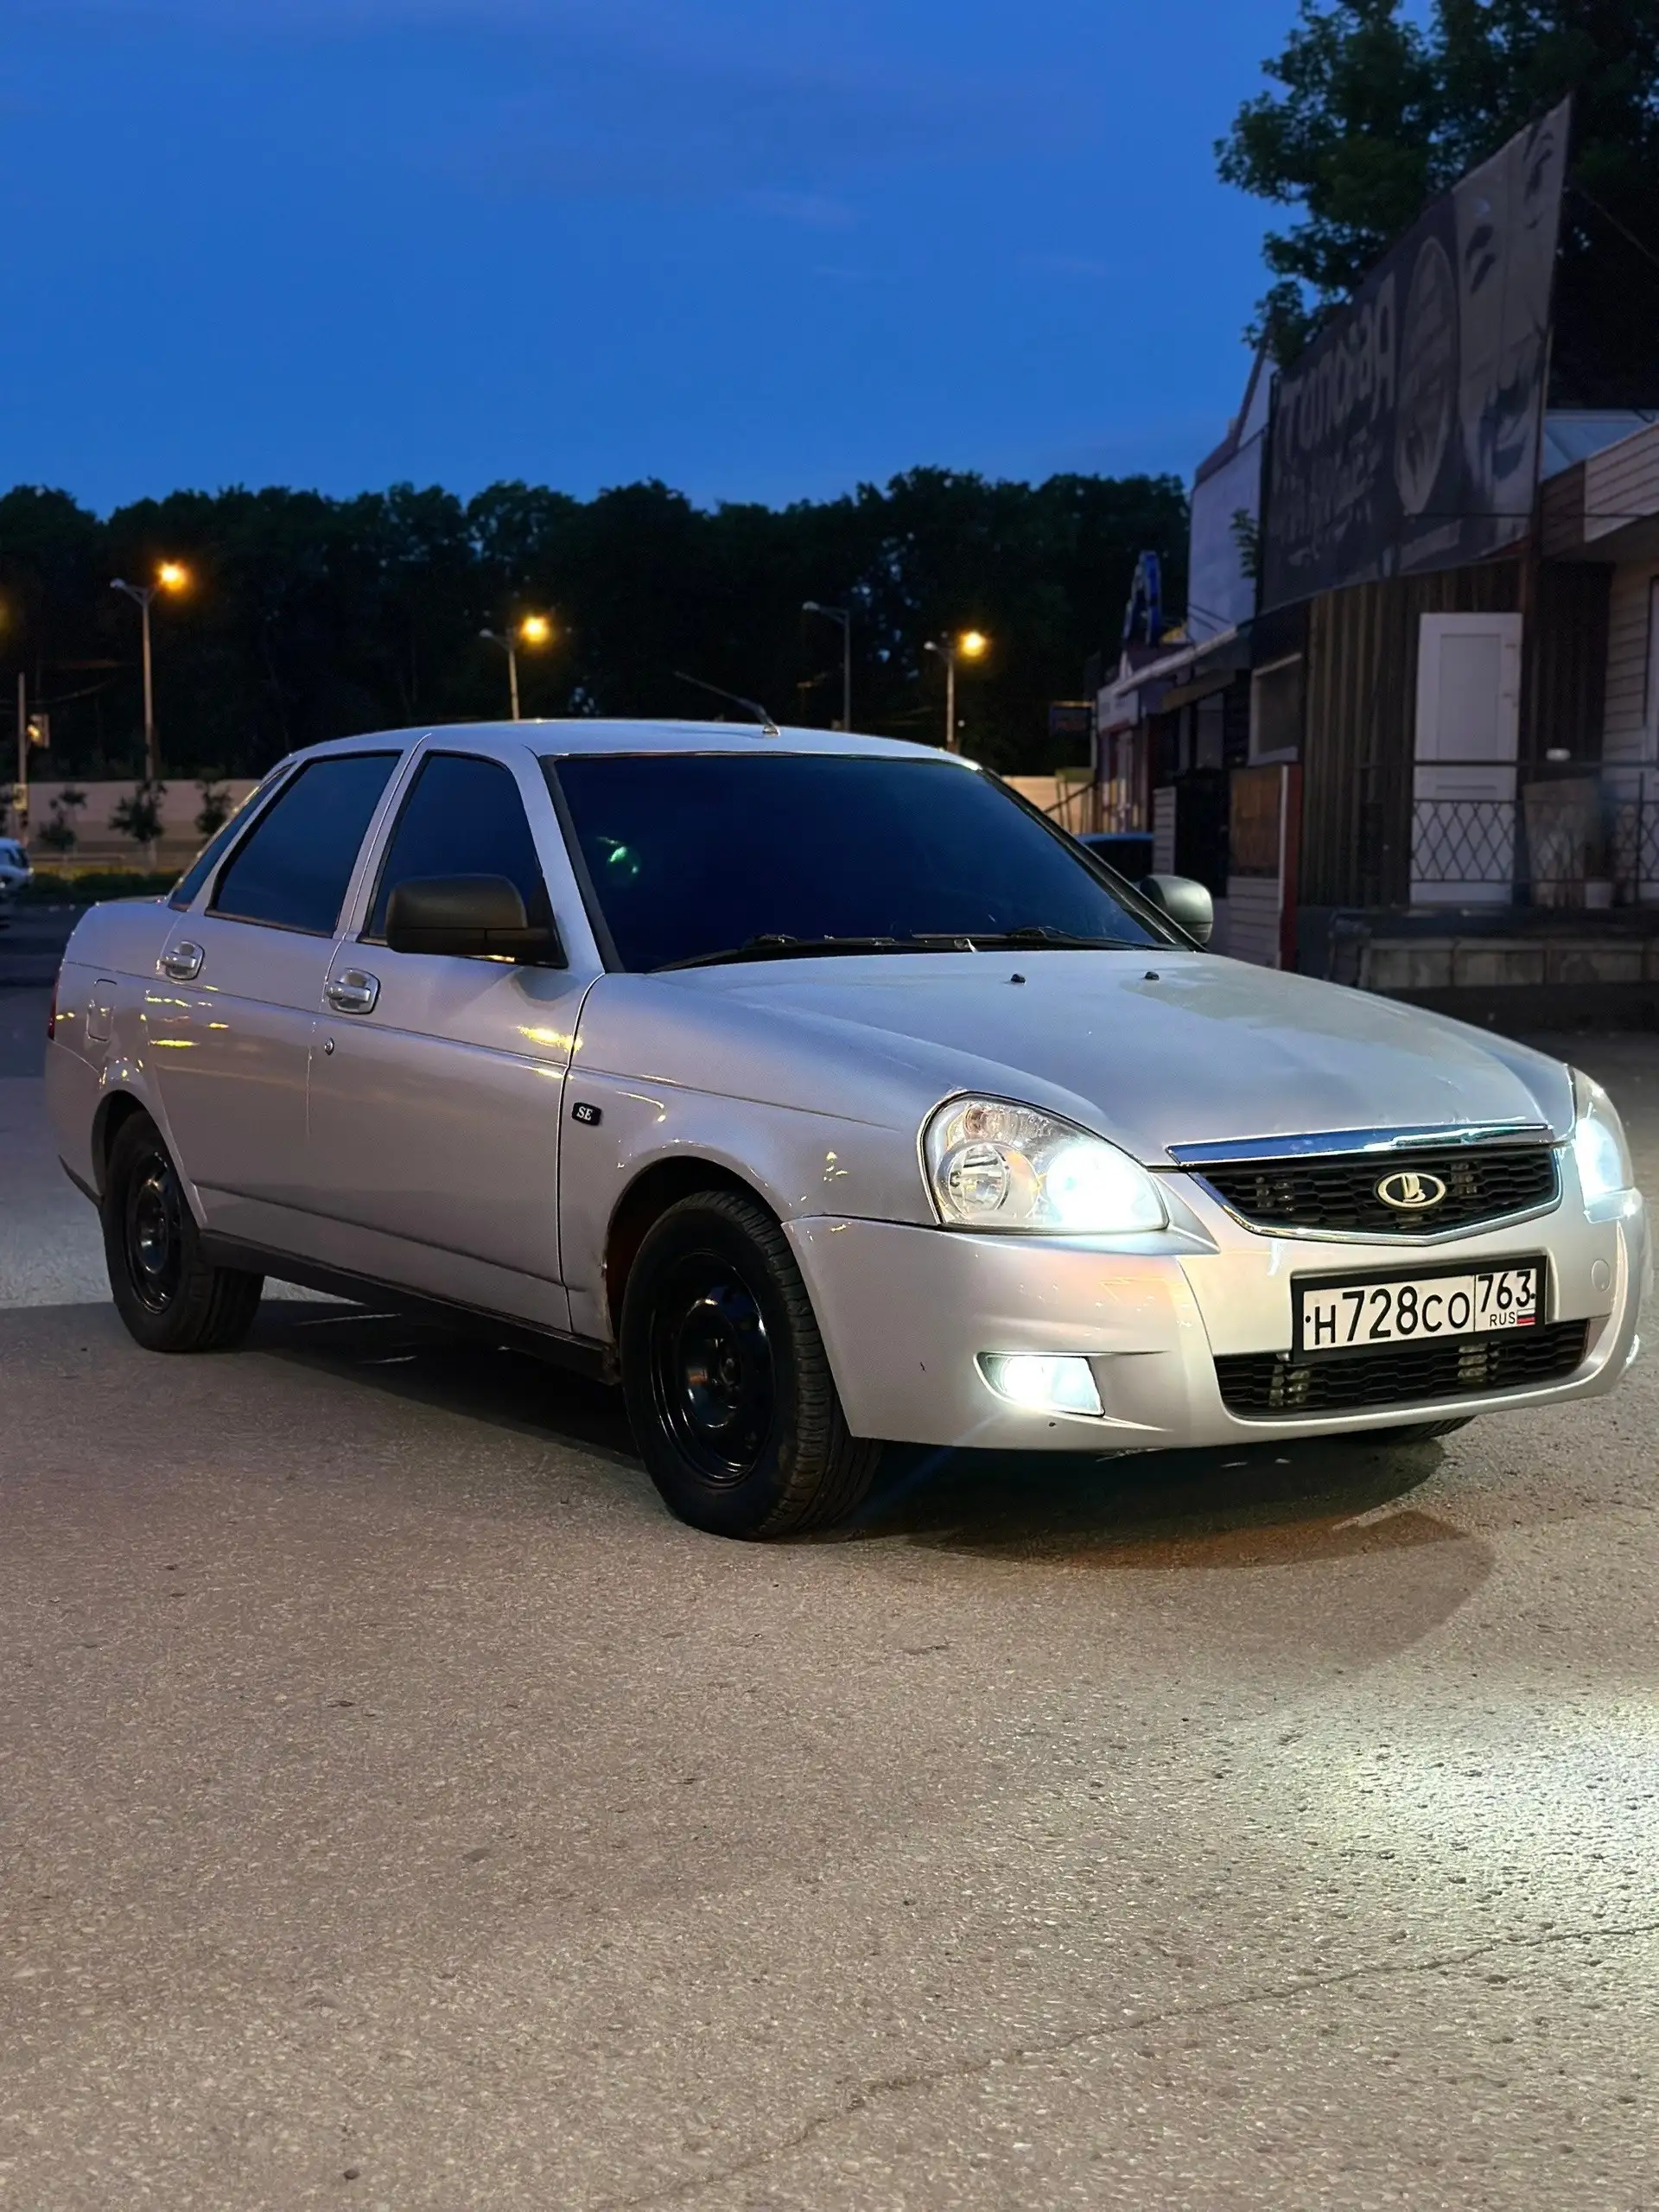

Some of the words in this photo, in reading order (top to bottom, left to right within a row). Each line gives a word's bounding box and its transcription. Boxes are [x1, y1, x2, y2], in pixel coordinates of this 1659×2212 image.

[576, 1106, 593, 1121] SE
[1478, 1270, 1532, 1313] 763
[1489, 1311, 1516, 1327] RUS
